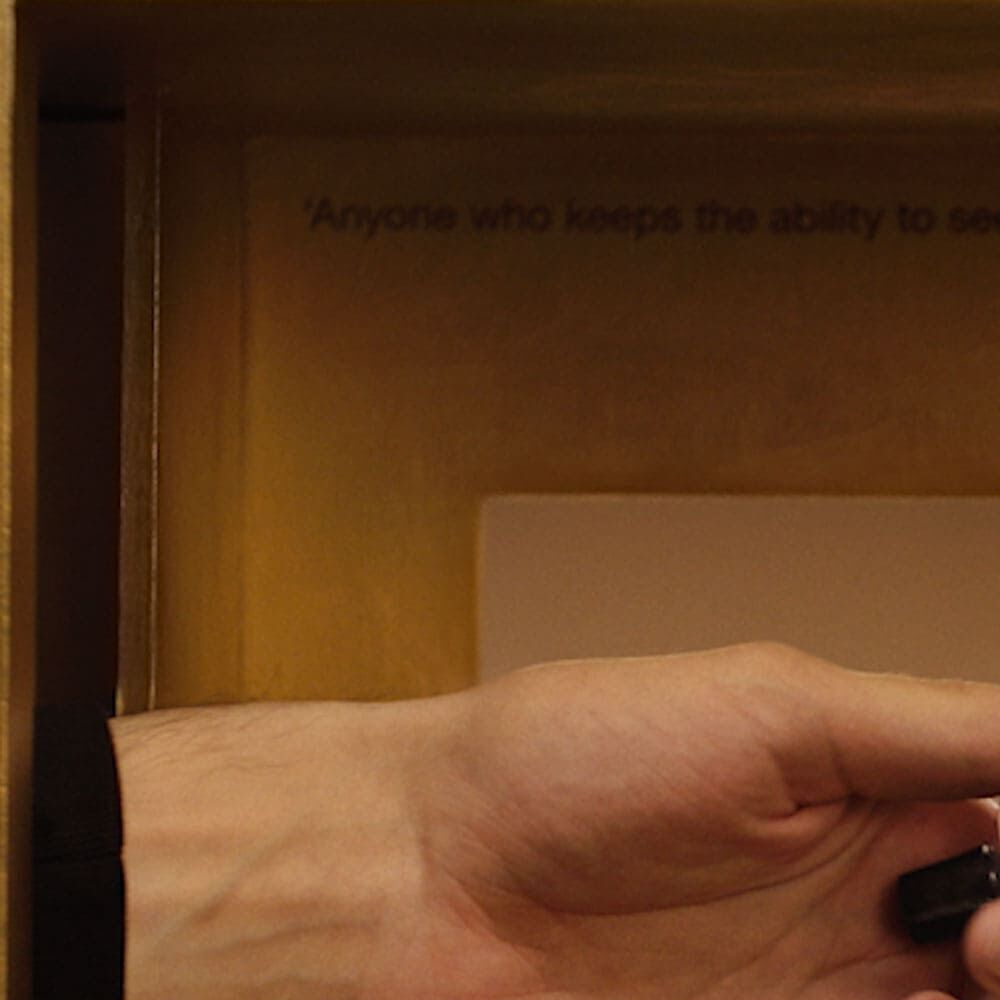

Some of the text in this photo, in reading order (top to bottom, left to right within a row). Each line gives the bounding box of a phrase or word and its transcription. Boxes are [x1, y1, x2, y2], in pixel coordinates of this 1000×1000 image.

[468, 199, 552, 232] who
[565, 199, 683, 240] keeps
[696, 200, 757, 232] the
[768, 199, 883, 240] ability
[898, 202, 936, 232] to
